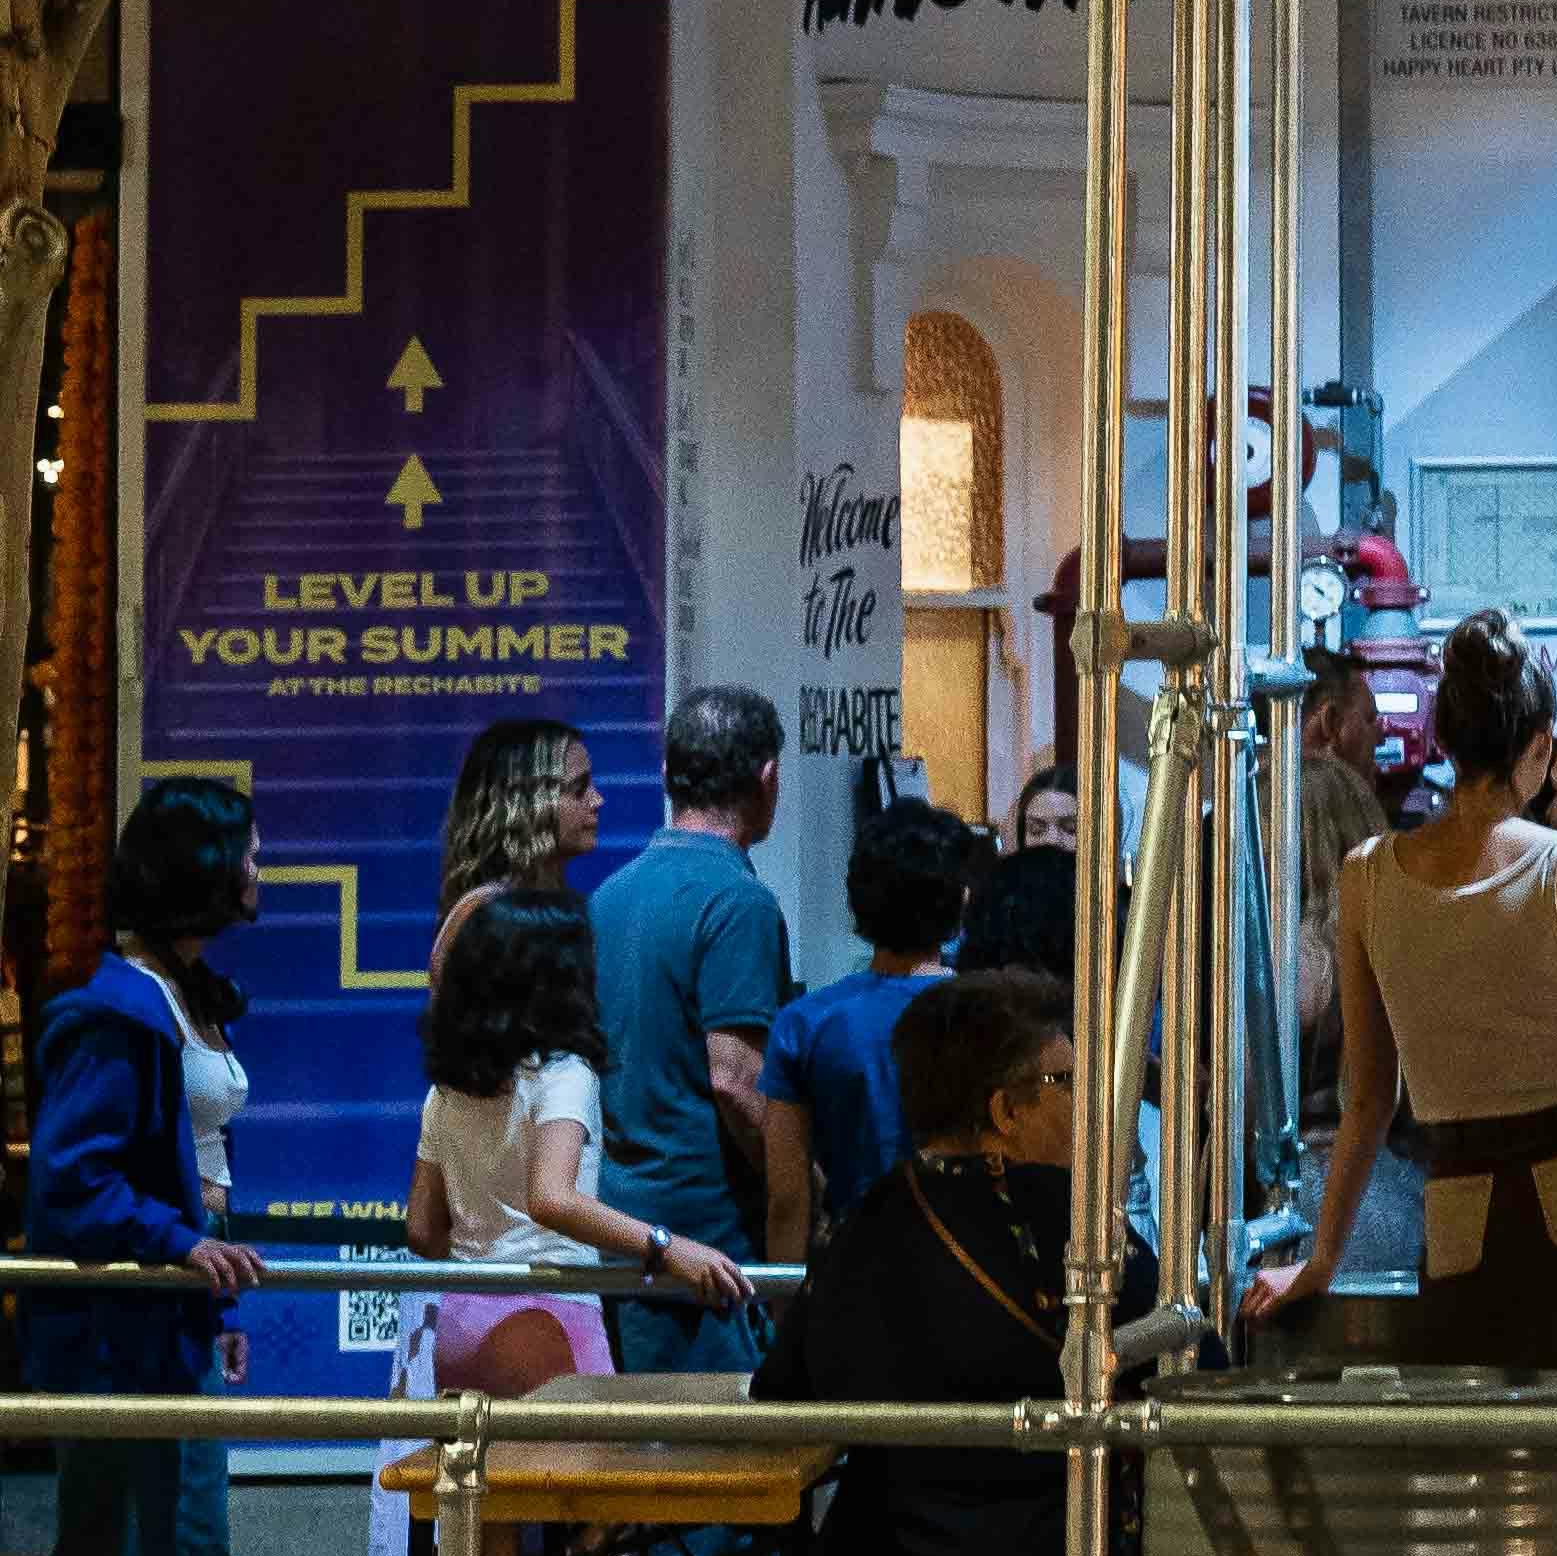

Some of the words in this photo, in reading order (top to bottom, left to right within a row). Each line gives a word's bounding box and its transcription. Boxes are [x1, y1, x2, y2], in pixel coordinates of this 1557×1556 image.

[1400, 3, 1468, 24] TAVERN
[1410, 30, 1486, 52] LICENCE
[1492, 29, 1518, 50] NO
[1383, 57, 1441, 77] HAPPY
[1447, 56, 1505, 77] HEART
[1512, 56, 1545, 76] PTY
[800, 462, 899, 566] Welcome
[263, 570, 455, 610] LEVEL
[464, 570, 551, 609] UP
[824, 567, 877, 660] The
[178, 626, 348, 665] YOUR
[360, 623, 630, 663] SUMMER
[266, 676, 300, 697] AT
[309, 674, 369, 696] THE
[372, 672, 543, 695] RECHABITE
[340, 1200, 409, 1221] WH
